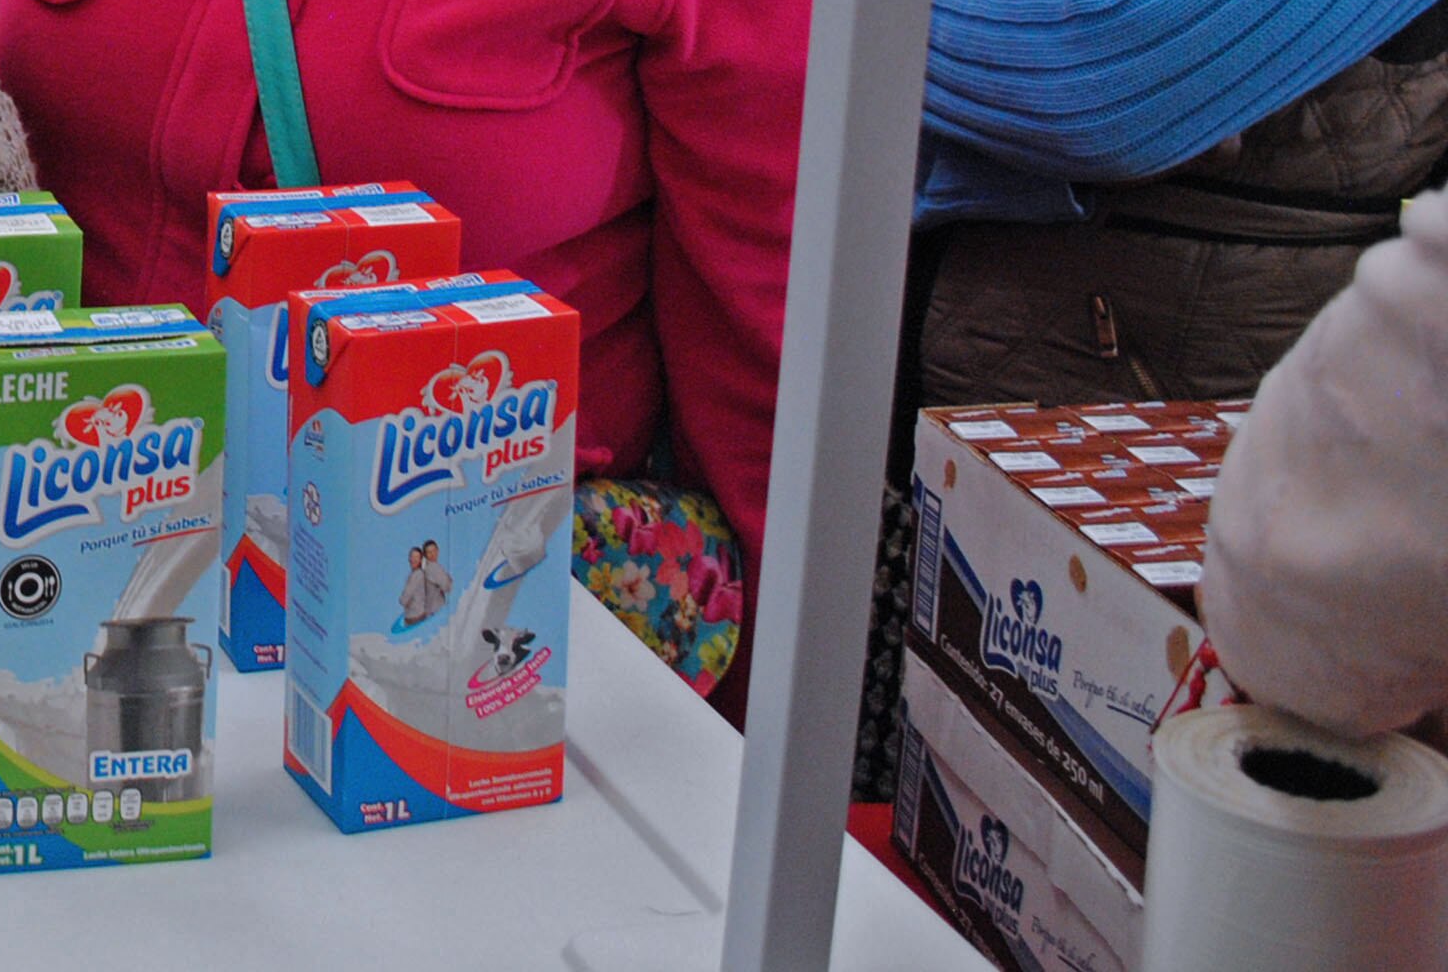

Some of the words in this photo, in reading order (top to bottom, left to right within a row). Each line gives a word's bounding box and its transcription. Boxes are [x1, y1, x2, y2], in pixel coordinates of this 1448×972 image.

[377, 387, 549, 506] Liconsa
[485, 435, 545, 477] plus
[3, 425, 195, 539] Liconsa
[125, 475, 191, 516] plus
[444, 493, 488, 517] Porque
[79, 532, 129, 554] Porque
[983, 592, 1062, 674] Liconsa
[1030, 667, 1058, 696] plus
[94, 753, 188, 778] ENTERA
[956, 824, 1024, 916] Liconsa
